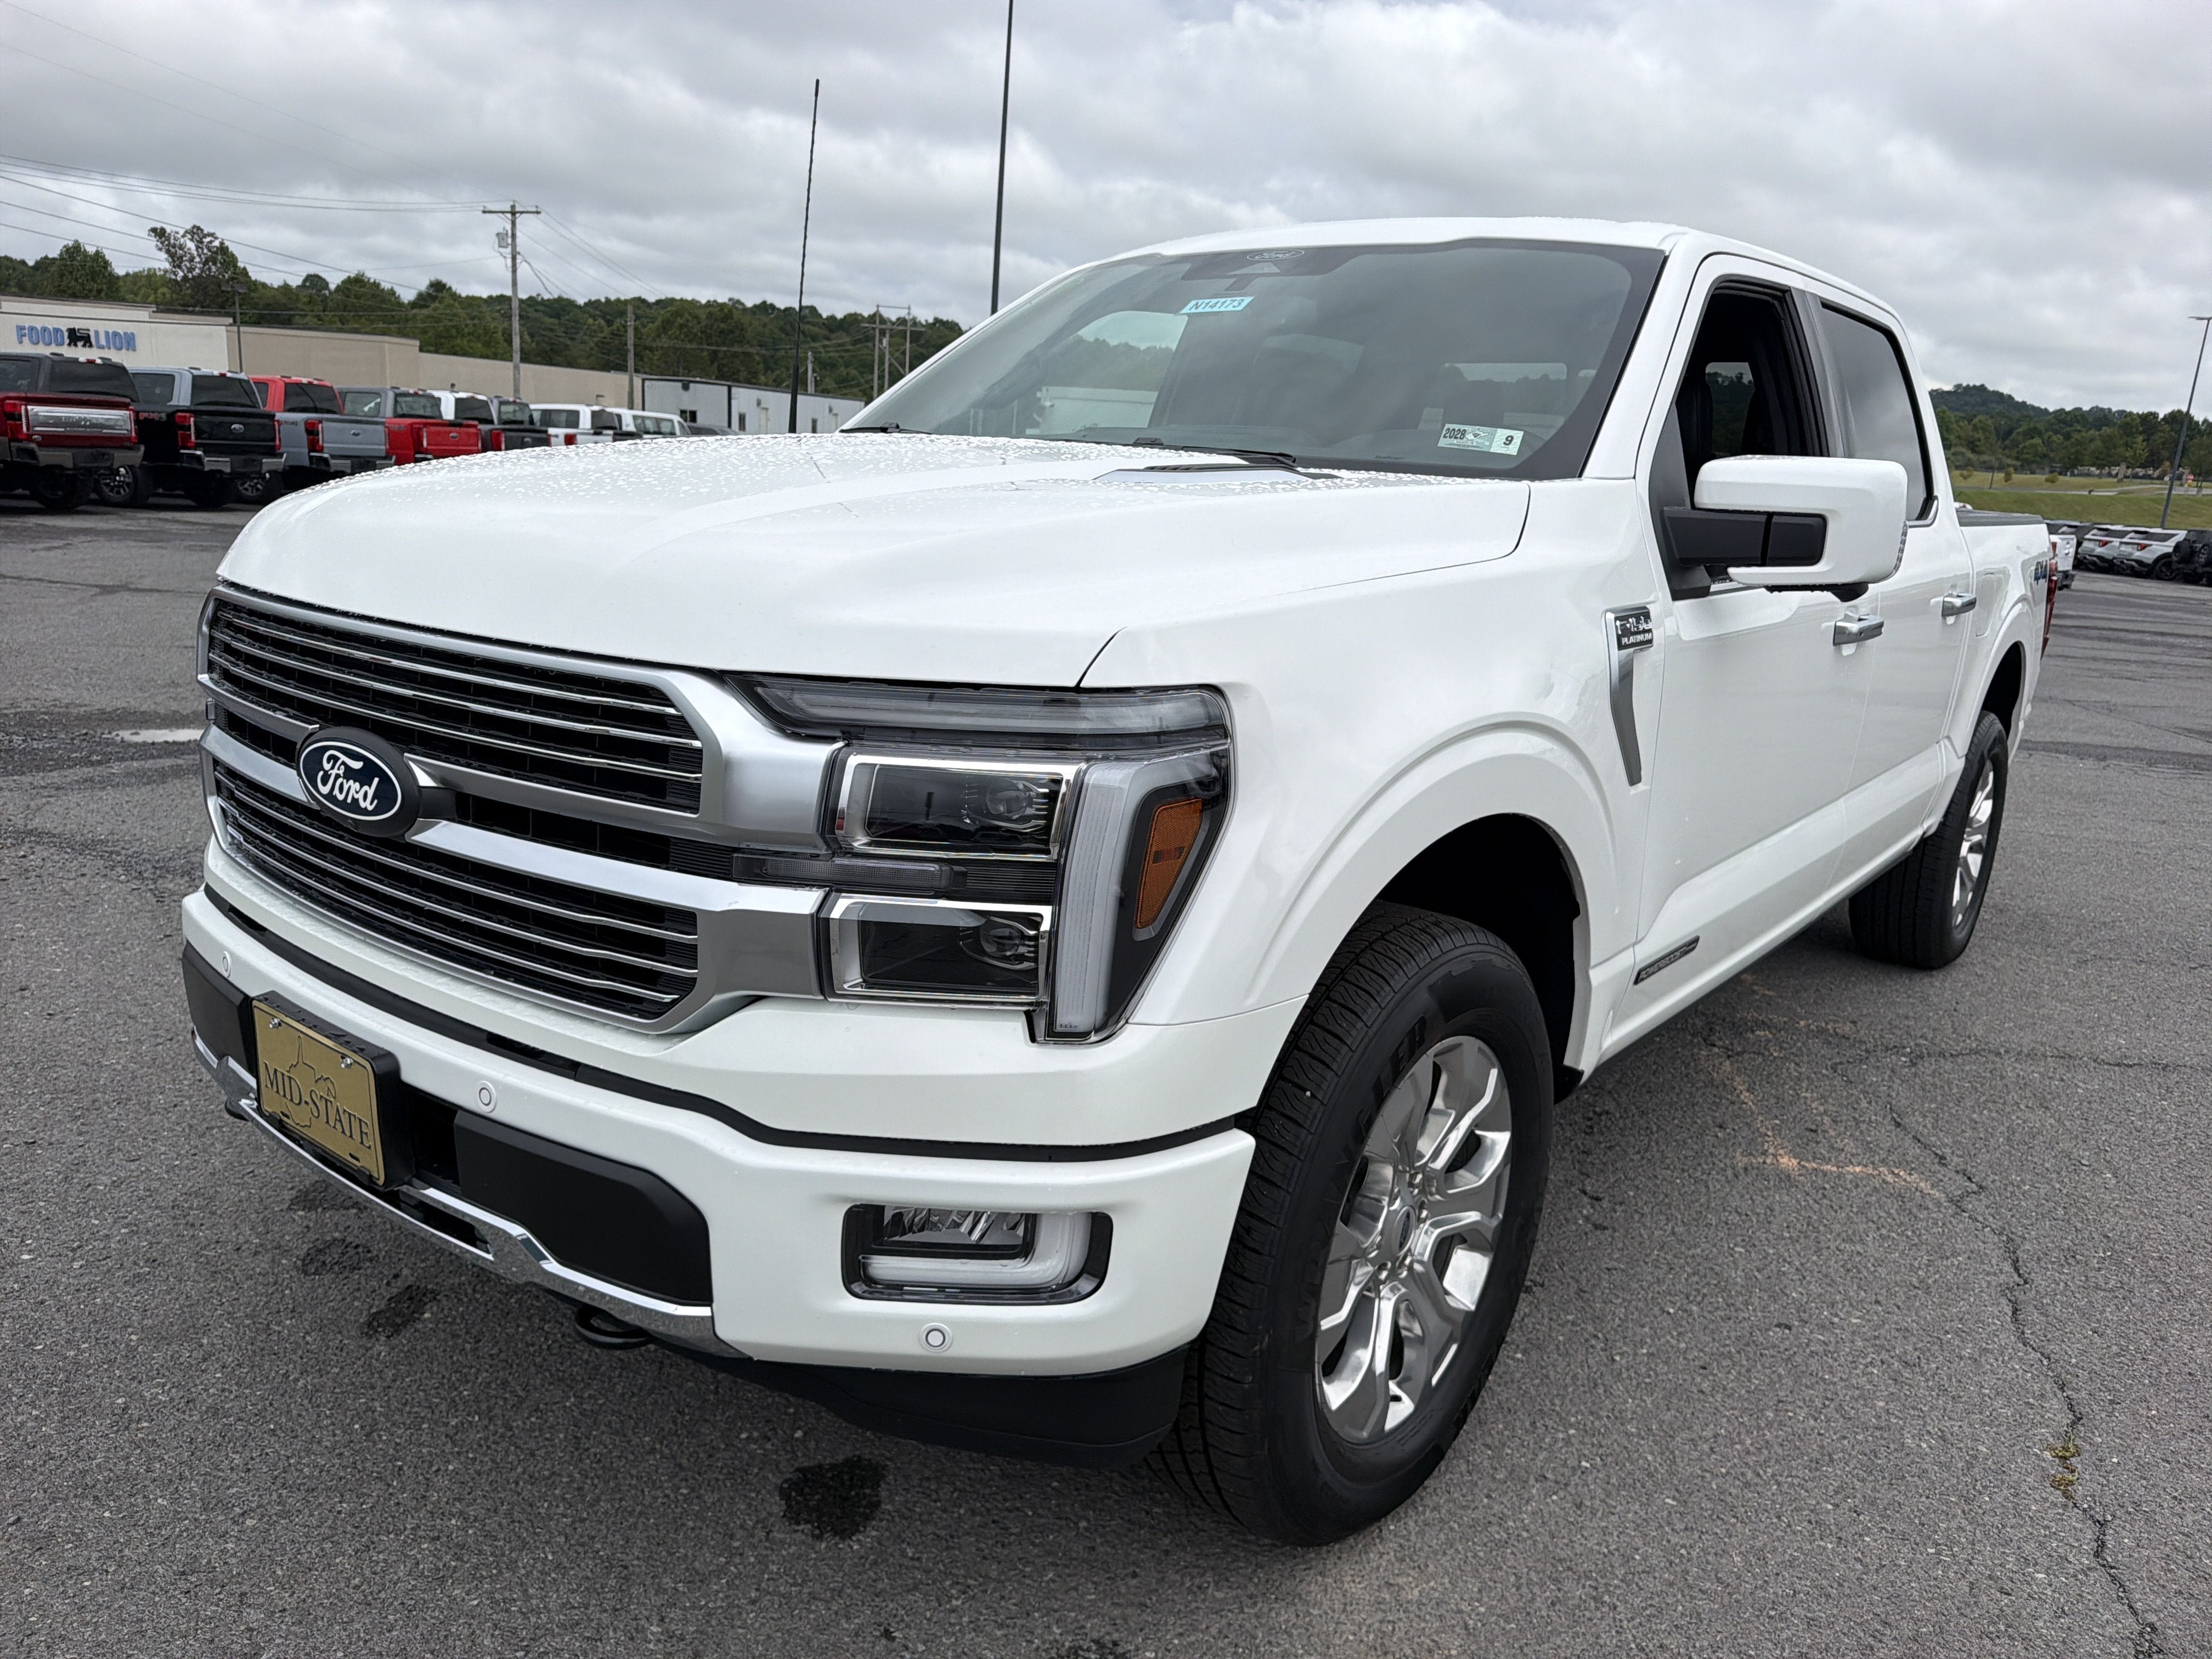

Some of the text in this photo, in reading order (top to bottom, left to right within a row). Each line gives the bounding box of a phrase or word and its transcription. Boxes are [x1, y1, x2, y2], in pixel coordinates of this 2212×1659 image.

[1188, 298, 1244, 311] N14173
[15, 324, 137, 351] FOOD LION
[1442, 427, 1514, 445] 2028 9
[1622, 633, 1652, 645] PLATINUM
[317, 749, 380, 811] Ford
[263, 1060, 373, 1150] MID-STATE
